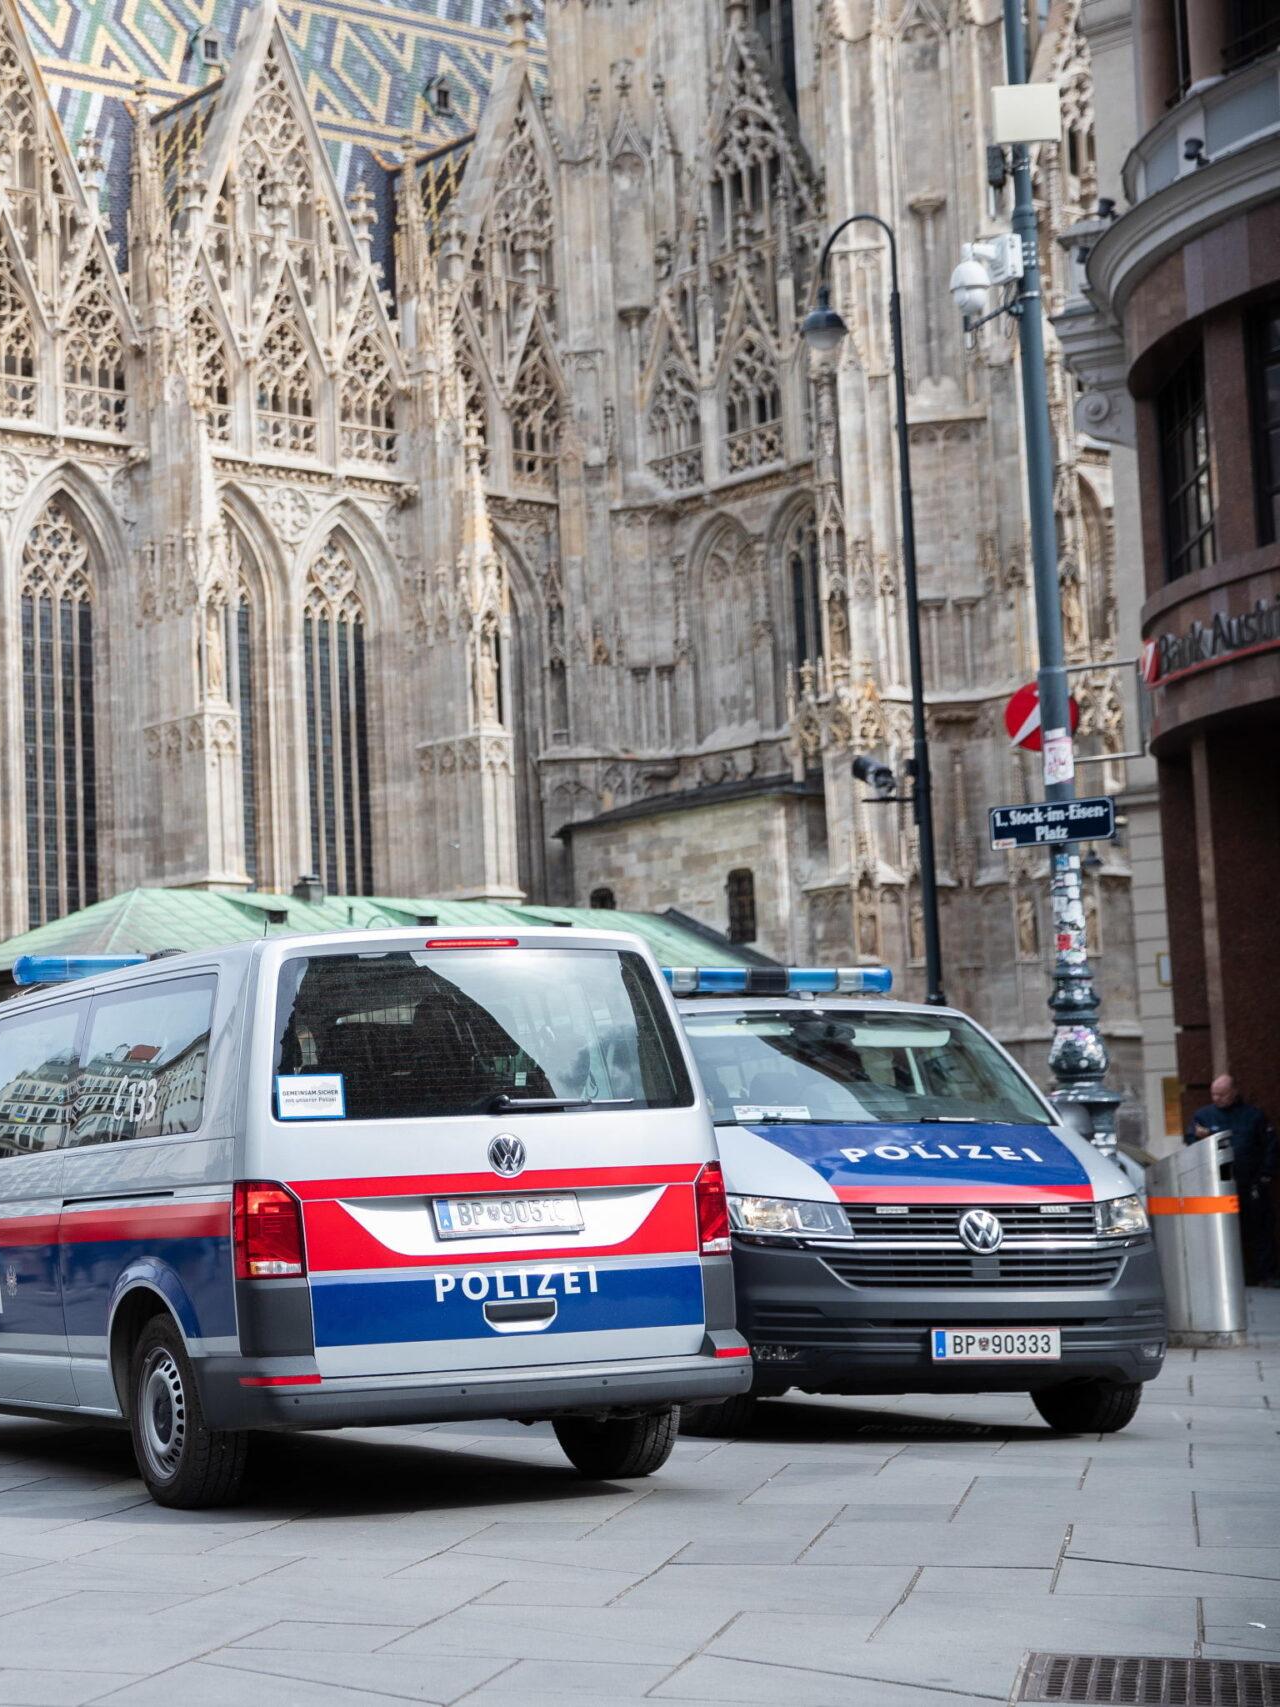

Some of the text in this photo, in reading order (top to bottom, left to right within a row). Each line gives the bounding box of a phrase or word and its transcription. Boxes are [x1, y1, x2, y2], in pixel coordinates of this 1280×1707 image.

[1159, 620, 1208, 676] Bank
[1009, 804, 1108, 826] Stock-im-Eisen-
[1035, 824, 1068, 841] Platz
[129, 1078, 157, 1122] 133
[840, 1145, 1043, 1163] POLIZEI
[457, 1201, 484, 1226] BP
[434, 1265, 598, 1303] POLIZEI
[953, 1335, 976, 1354] BP
[992, 1334, 1051, 1354] 90333
